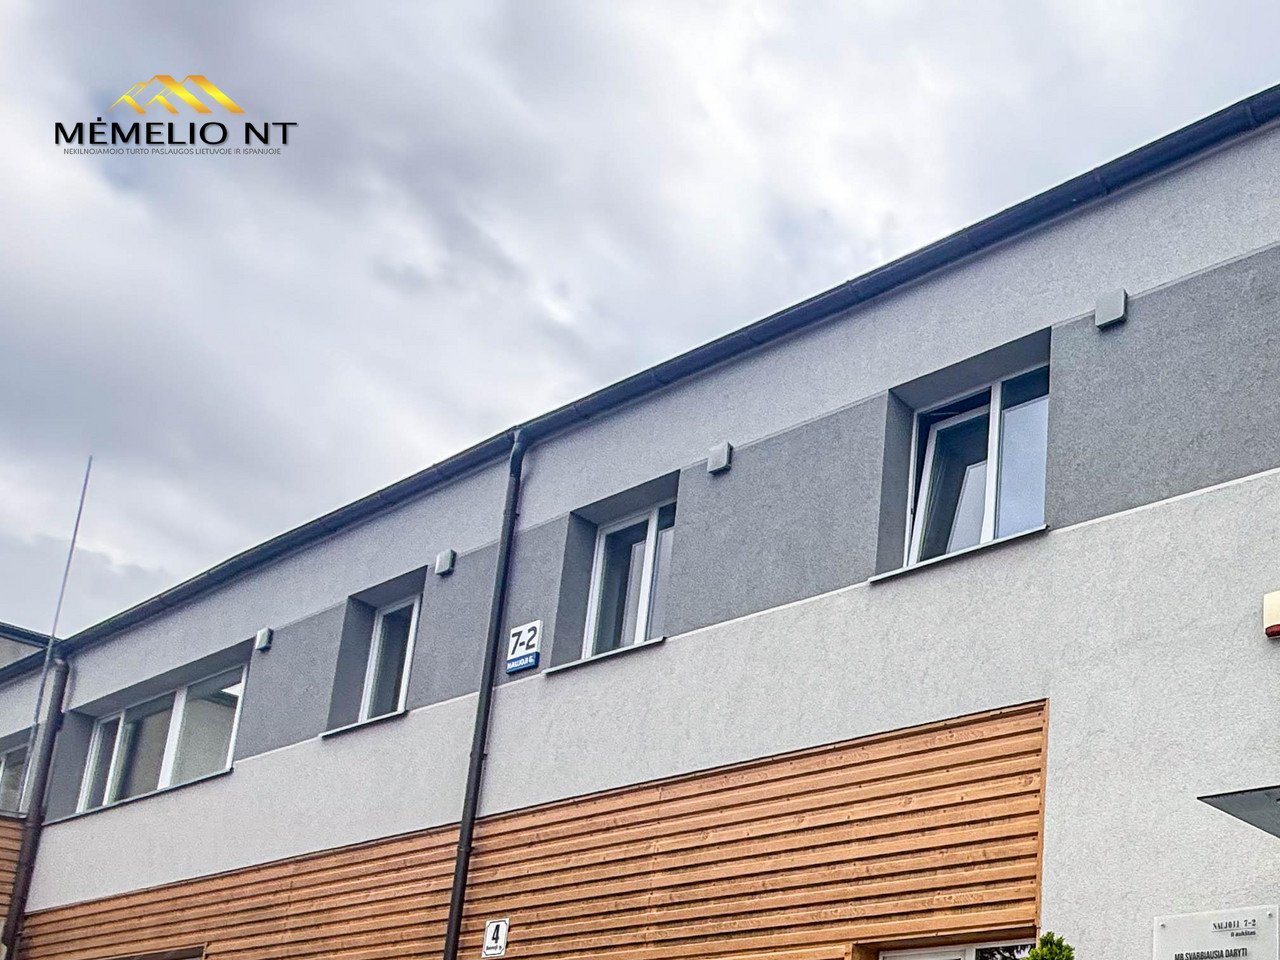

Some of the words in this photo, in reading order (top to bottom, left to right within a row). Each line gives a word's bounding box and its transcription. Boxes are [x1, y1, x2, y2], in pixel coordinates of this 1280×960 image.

[511, 626, 538, 656] 7-2
[491, 924, 500, 944] 4
[1185, 950, 1224, 960] SVARBIAUSIA
[1225, 948, 1248, 958] DARYTI
